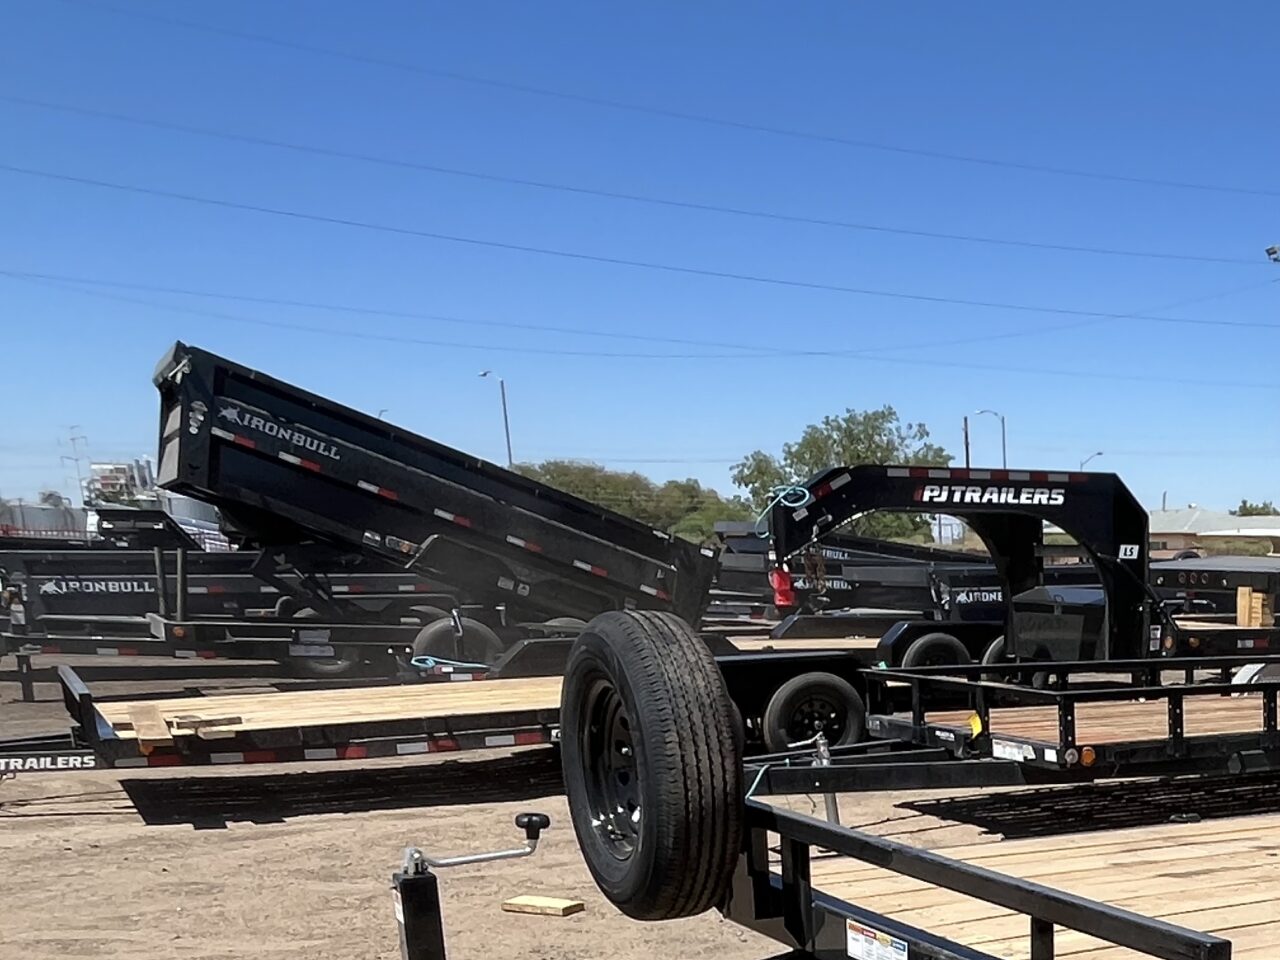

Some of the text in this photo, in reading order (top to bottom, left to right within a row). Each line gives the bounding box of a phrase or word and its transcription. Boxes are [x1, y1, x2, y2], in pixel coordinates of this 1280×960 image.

[242, 413, 340, 460] IRONBULL
[60, 581, 155, 593] IRONBULL
[0, 755, 96, 770] TRAILERS
